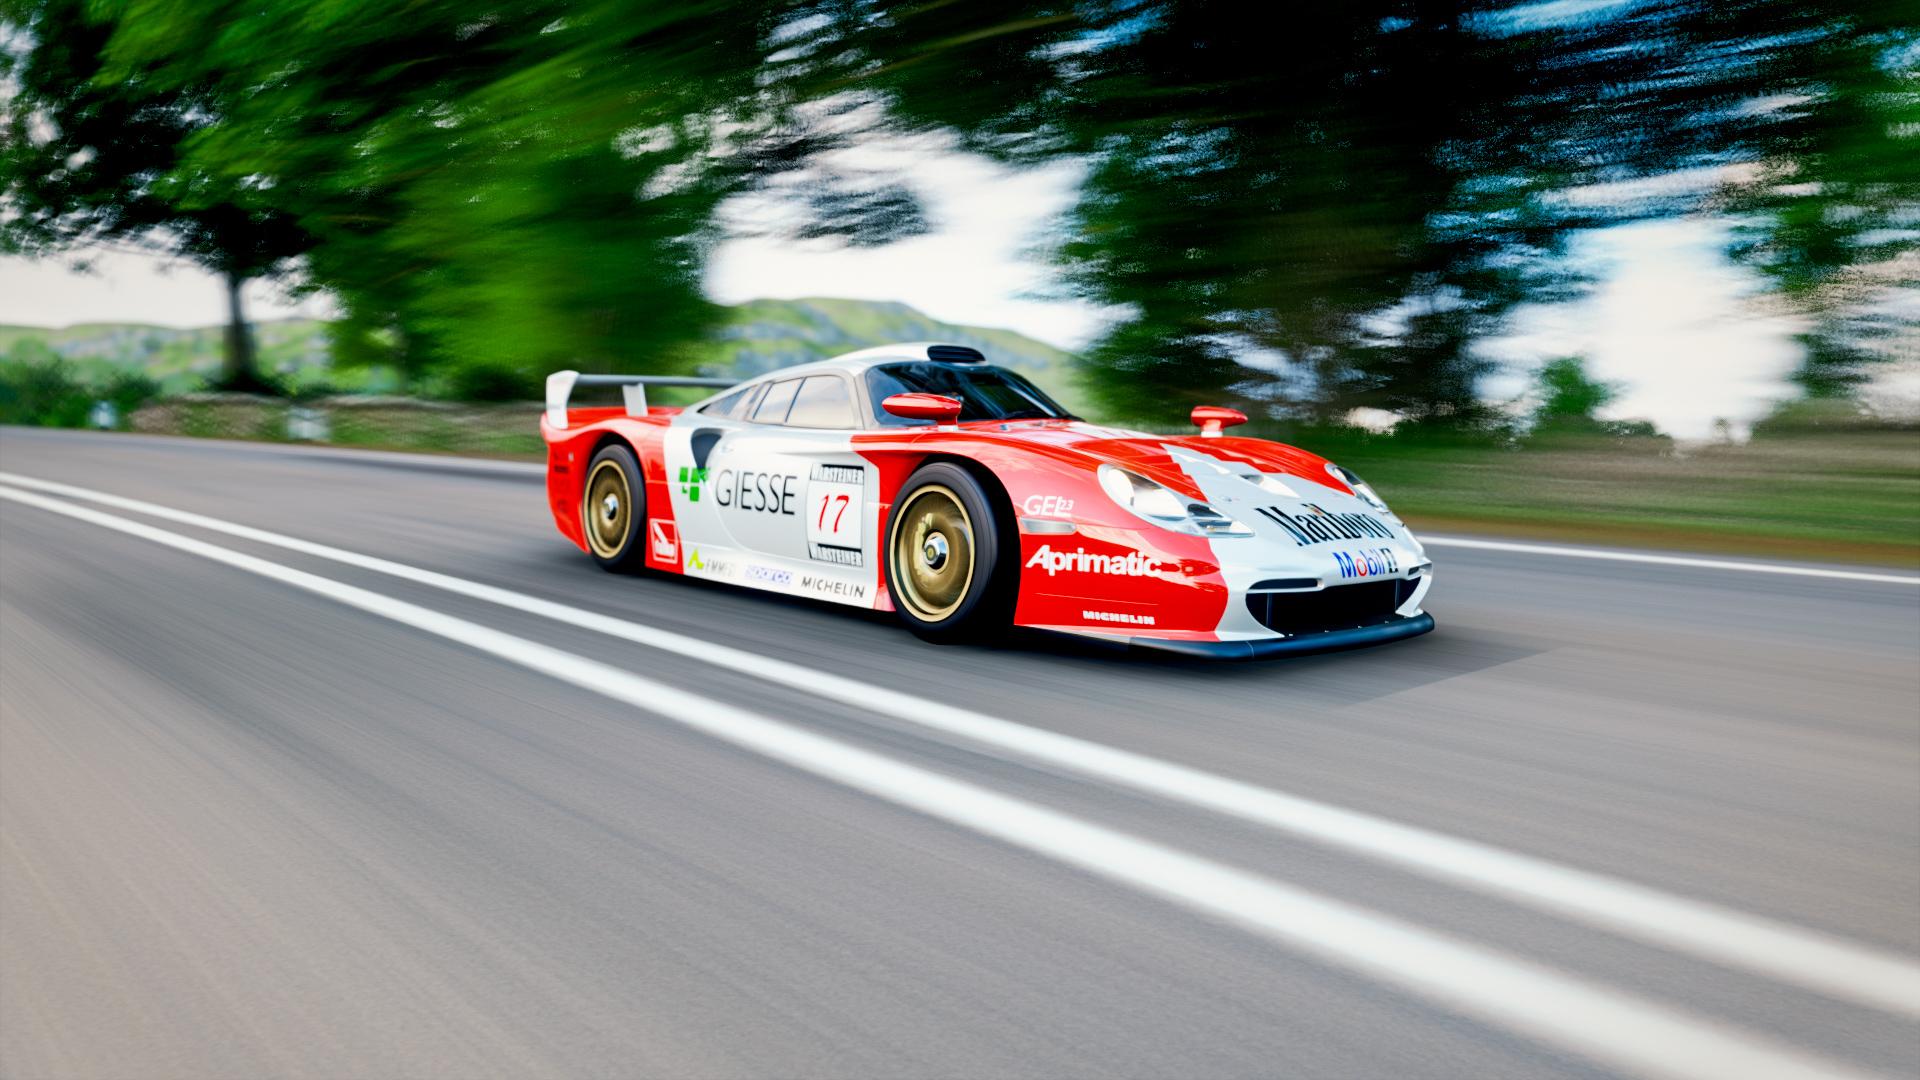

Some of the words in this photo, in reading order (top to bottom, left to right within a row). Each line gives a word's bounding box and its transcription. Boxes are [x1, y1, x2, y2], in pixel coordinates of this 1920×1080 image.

[716, 469, 798, 516] GIESSE
[818, 494, 850, 534] 17
[1254, 503, 1396, 547] Marlboro
[1025, 544, 1163, 578] Aprimatic
[1332, 549, 1386, 579] Mobil
[801, 575, 866, 599] MICHELIN
[1082, 610, 1156, 626] MICHELIN
